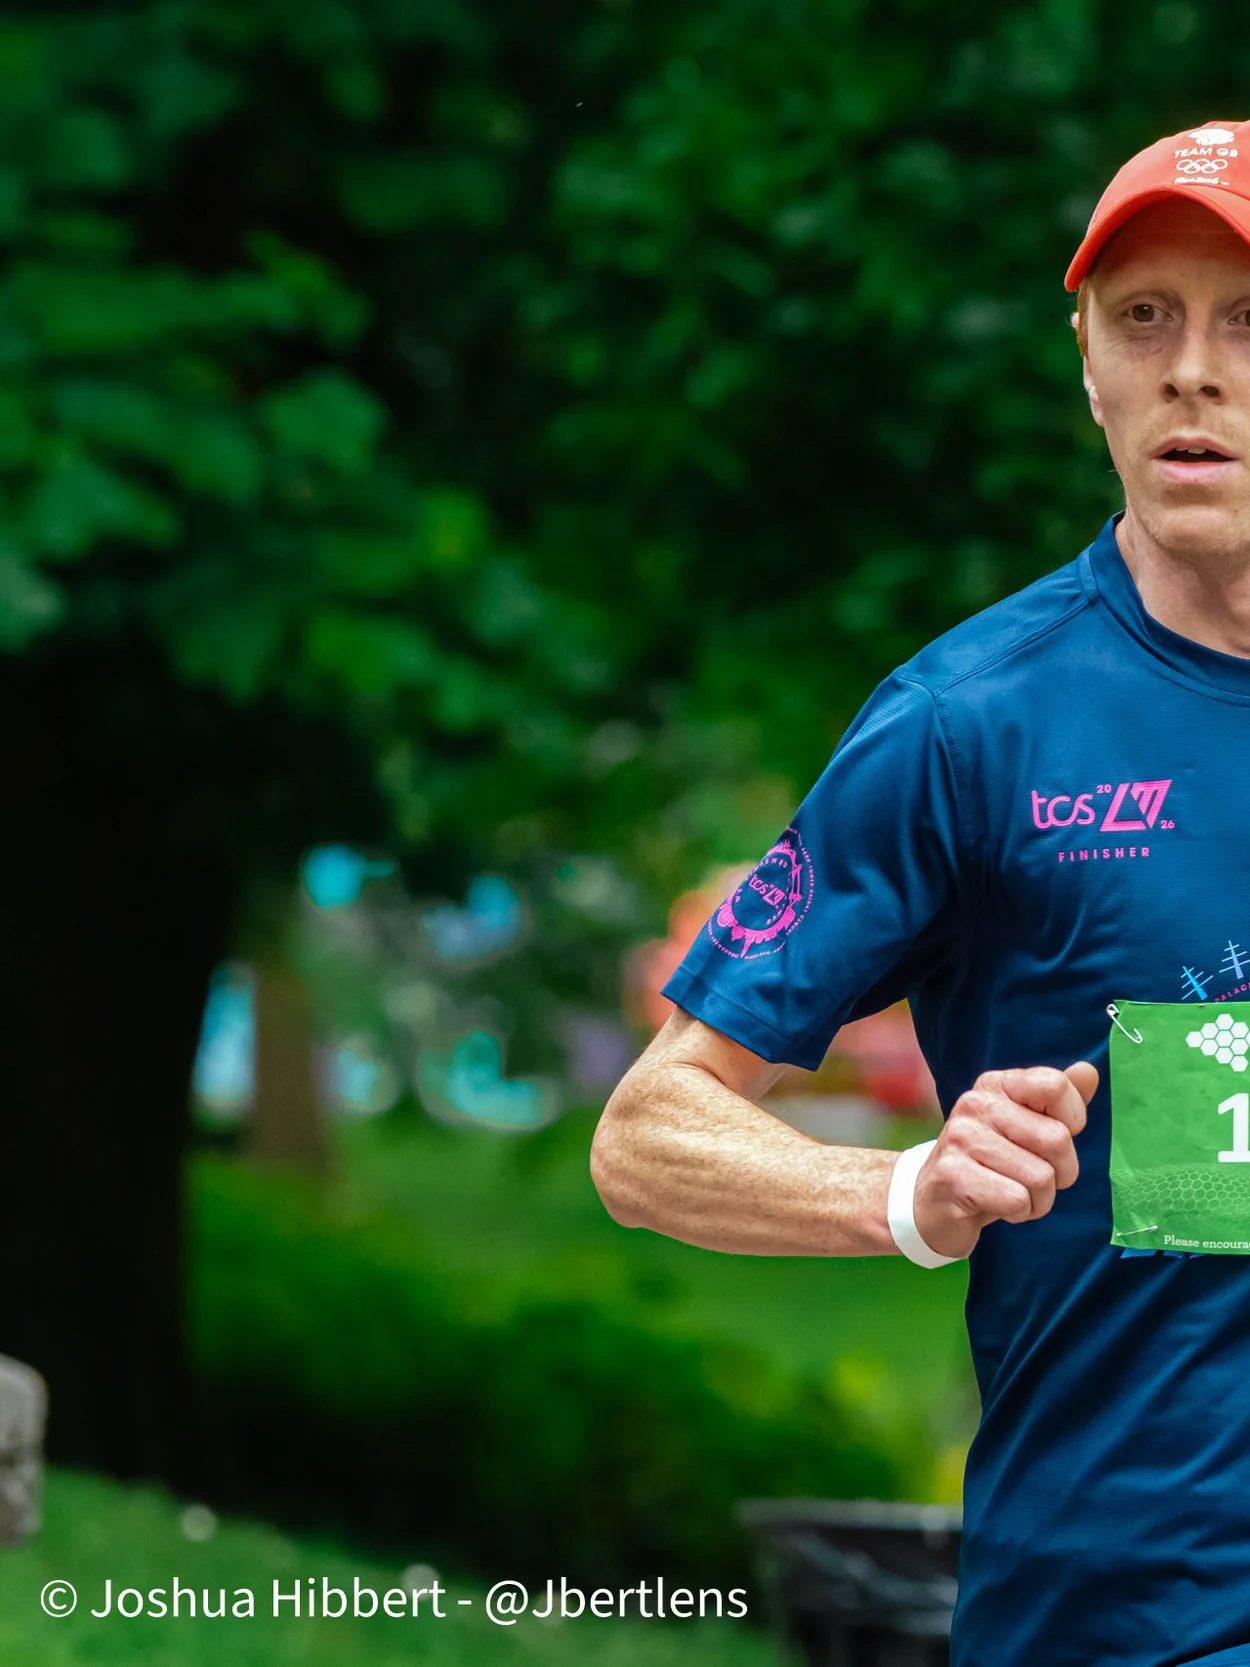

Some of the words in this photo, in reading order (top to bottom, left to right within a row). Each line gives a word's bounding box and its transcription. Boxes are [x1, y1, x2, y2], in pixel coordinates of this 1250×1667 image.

[1174, 147, 1213, 158] TEAM
[1031, 789, 1096, 829] tcs
[1096, 783, 1112, 794] 20
[1160, 819, 1175, 829] 26
[1058, 847, 1150, 863] FINISHER
[1163, 1234, 1200, 1248] Please
